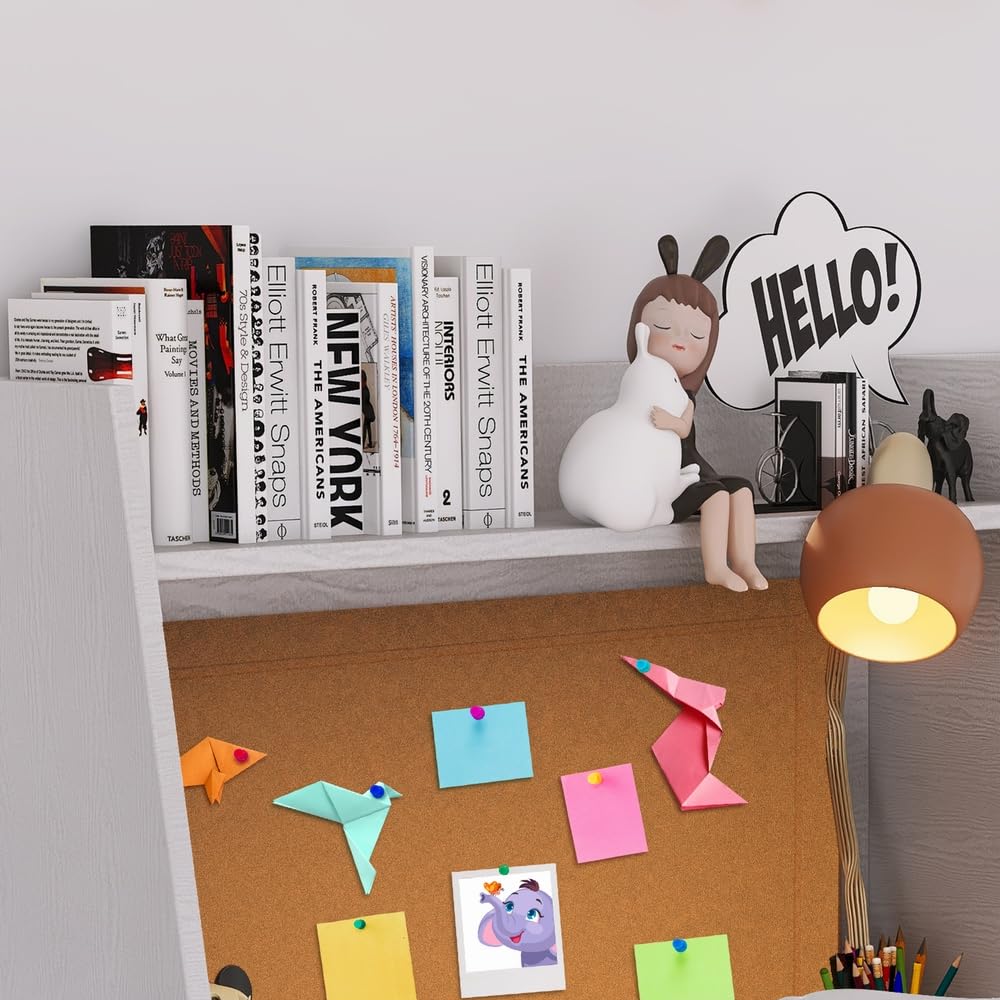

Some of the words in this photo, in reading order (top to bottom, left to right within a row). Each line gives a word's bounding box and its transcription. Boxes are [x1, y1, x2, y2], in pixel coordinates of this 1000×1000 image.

[238, 290, 248, 311] 70s
[268, 265, 287, 333] Elliott
[421, 255, 429, 299] VISIONARY
[476, 263, 494, 329] Elliott
[237, 313, 249, 346] Style
[422, 299, 431, 366] ARCHITECTURE
[751, 243, 900, 377] HELLO!
[155, 333, 176, 342] What
[171, 355, 183, 366] Say
[239, 349, 249, 360] &
[326, 312, 361, 406] NEW
[443, 321, 455, 400] INTERIORS
[188, 340, 199, 395] MOVIES
[239, 363, 249, 412] Design
[269, 343, 289, 415] Erwitt
[313, 360, 323, 392] THE
[392, 373, 398, 383] IN
[423, 366, 431, 379] OF
[477, 339, 495, 407] Erwitt
[519, 354, 527, 386] THE
[189, 399, 200, 429] AND
[424, 400, 432, 427] 20TH
[190, 431, 202, 497] METHODS
[268, 424, 290, 508] Snaps
[314, 399, 325, 500] AMERICANS
[424, 427, 432, 473] CENTURY
[475, 417, 496, 497] Snaps
[519, 393, 529, 490] AMERICANS
[328, 418, 363, 531] YORK
[442, 489, 451, 505] 2
